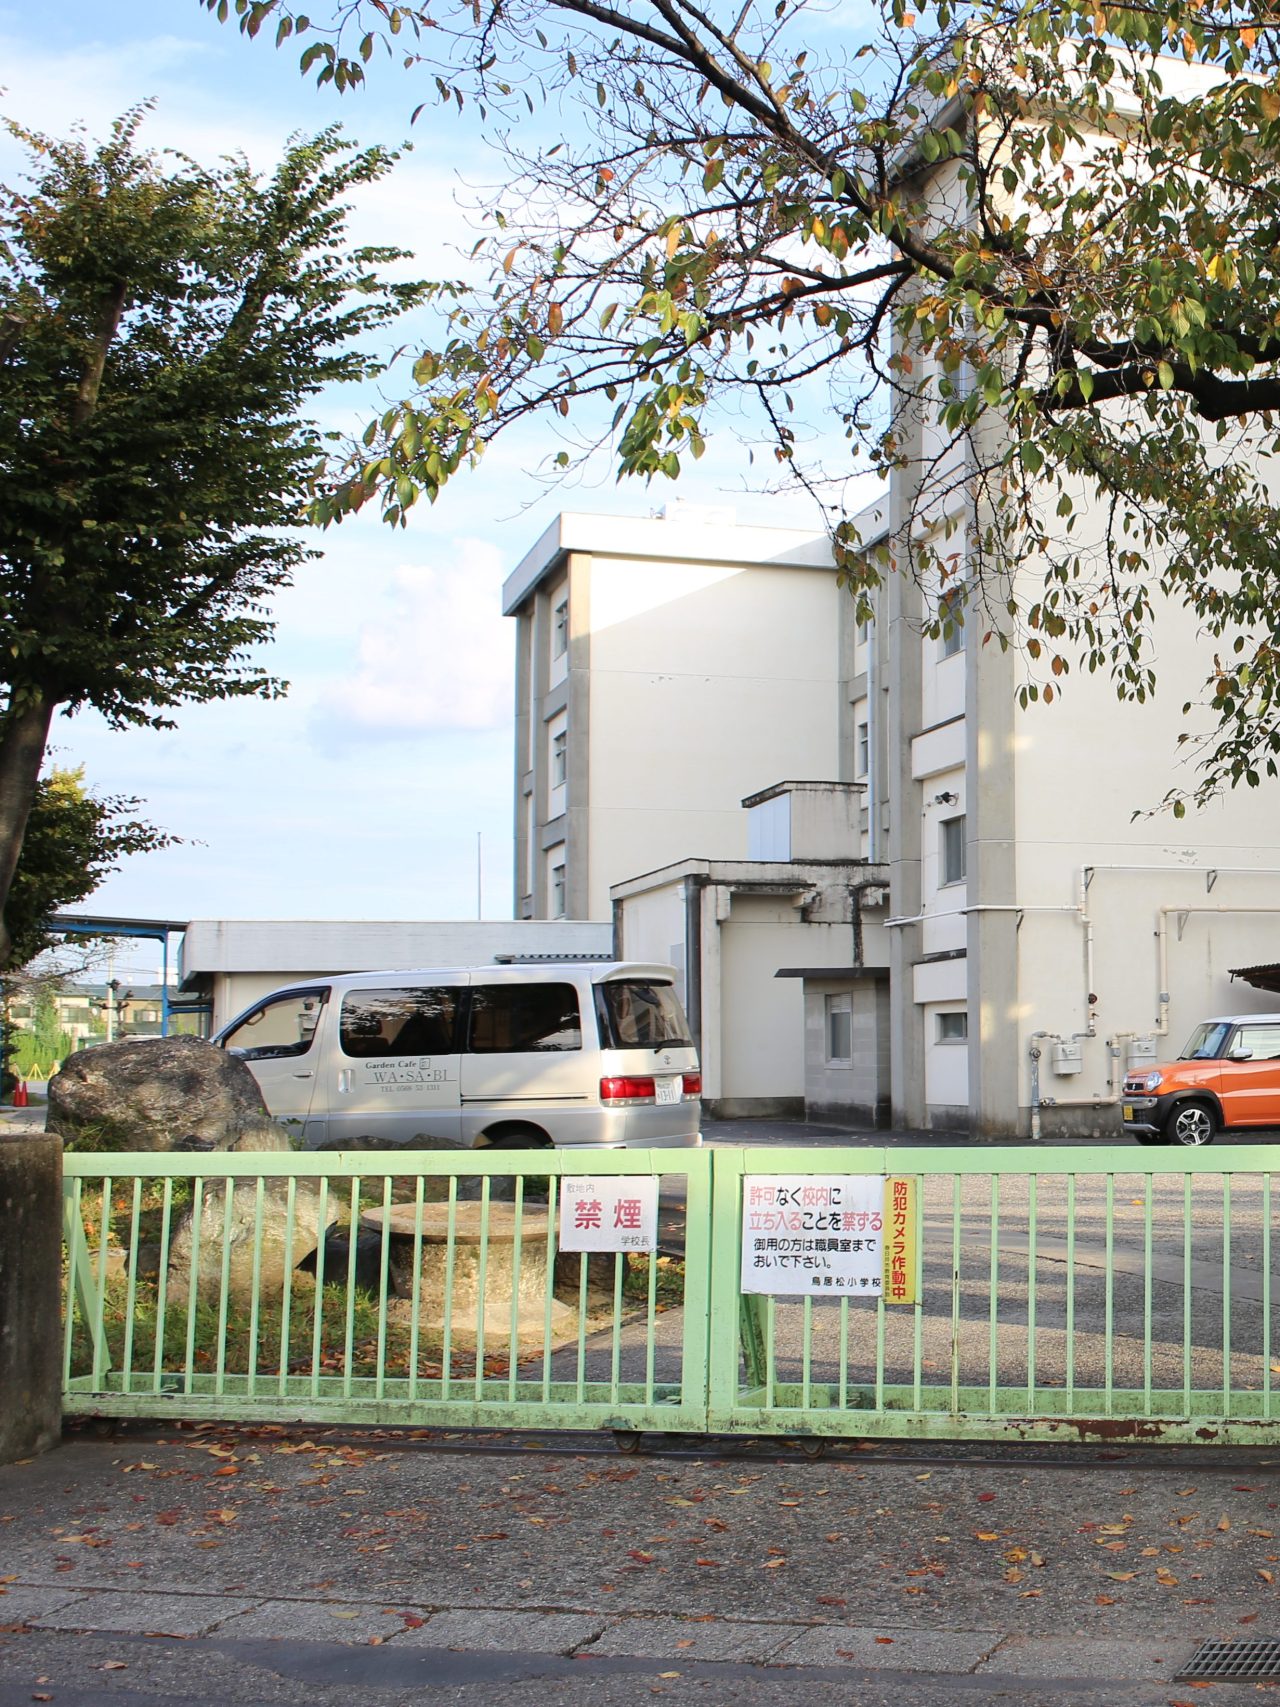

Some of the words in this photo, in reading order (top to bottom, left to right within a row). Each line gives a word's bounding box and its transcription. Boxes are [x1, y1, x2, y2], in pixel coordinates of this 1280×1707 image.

[566, 1183, 595, 1194] 敷地内
[750, 1186, 841, 1207] 許可なく校内に
[574, 1199, 642, 1230] 禁煙
[621, 1236, 650, 1247] 学校長
[753, 1238, 877, 1252] 御用の方は職員室まで
[892, 1181, 908, 1299] 防犯カメラ作動中
[811, 1277, 881, 1288] 鳥居松小学校
